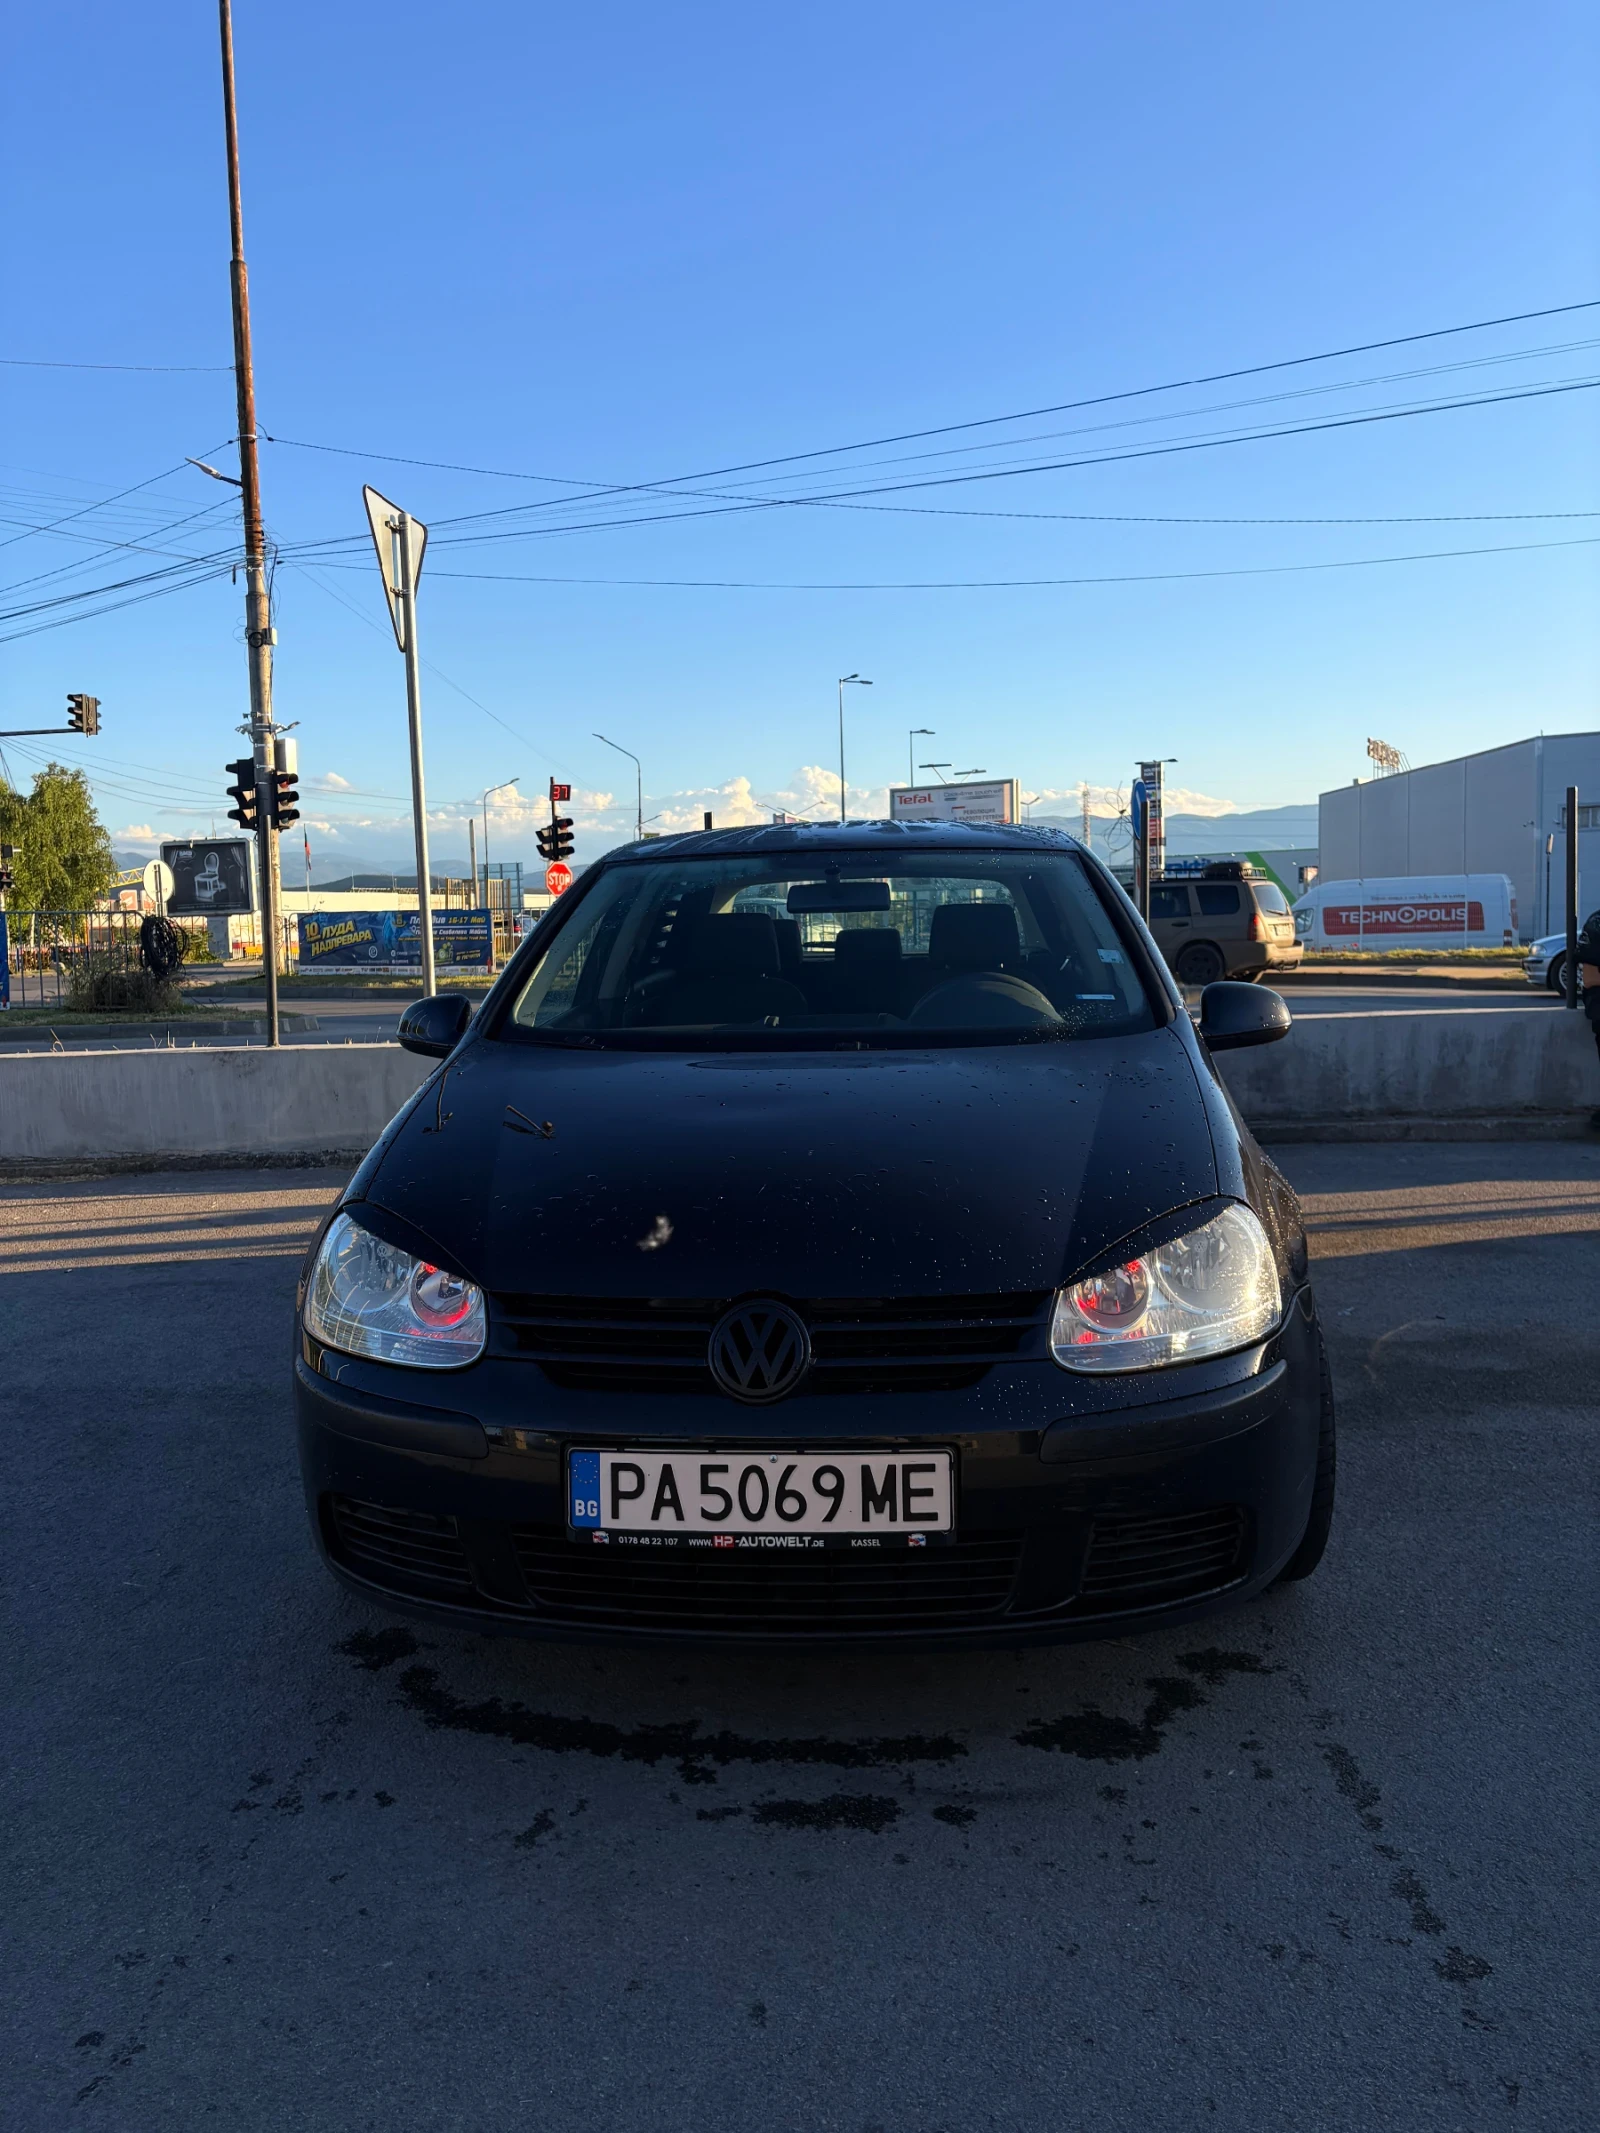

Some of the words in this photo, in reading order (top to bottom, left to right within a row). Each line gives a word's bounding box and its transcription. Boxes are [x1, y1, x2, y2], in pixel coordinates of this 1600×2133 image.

[553, 786, 568, 800] 37
[897, 793, 934, 805] Tefal
[548, 872, 570, 885] STOP
[1339, 906, 1467, 924] TECHNOPOLIS
[304, 921, 319, 939] 10
[322, 920, 355, 939] ЛУДА
[311, 929, 372, 957] НАДПРЕВАРА
[574, 1499, 598, 1517] BG
[618, 1536, 638, 1545] 0178
[640, 1536, 650, 1545] 48
[651, 1537, 662, 1545] 22
[664, 1537, 679, 1546] 107
[851, 1538, 881, 1547] KASSEL
